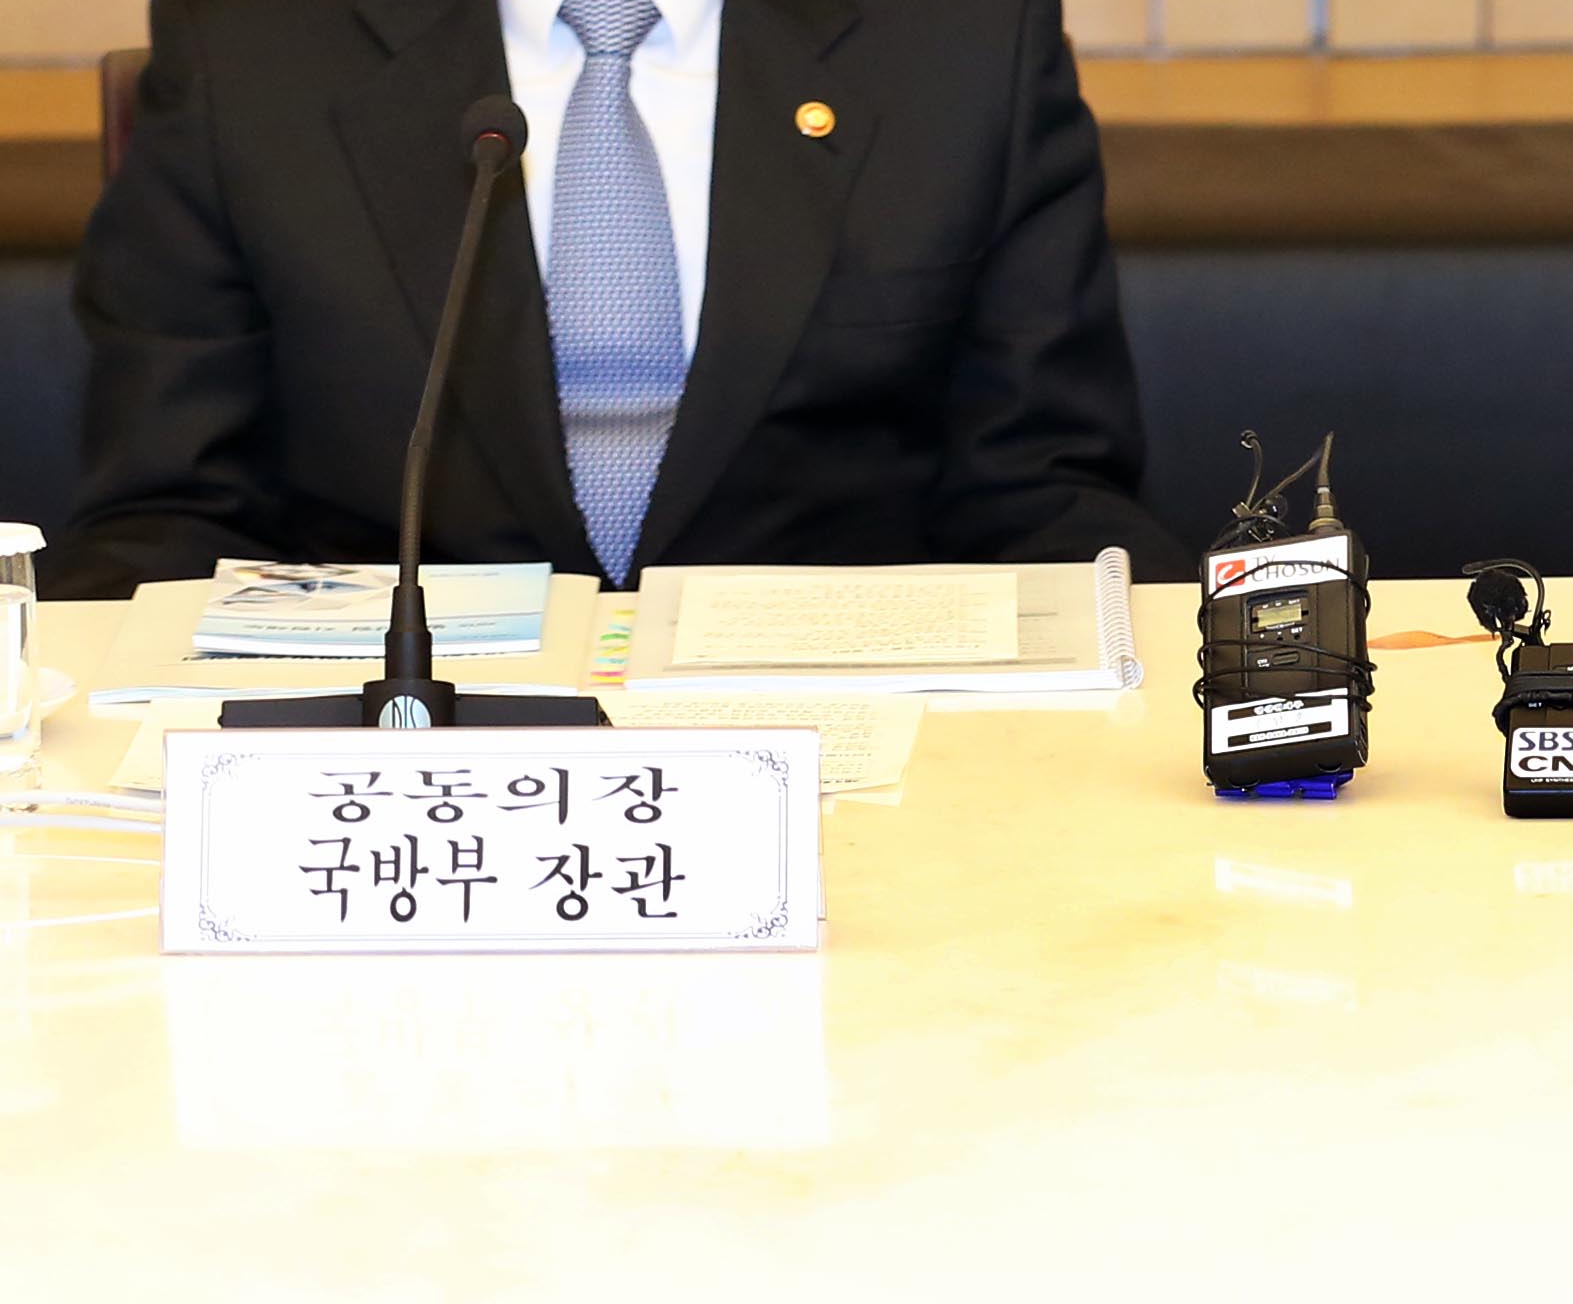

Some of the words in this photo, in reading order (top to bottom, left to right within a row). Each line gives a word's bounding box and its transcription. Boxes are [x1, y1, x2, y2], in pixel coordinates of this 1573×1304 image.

[308, 766, 679, 825] 공동의장
[298, 834, 498, 923] 국방부
[529, 843, 686, 921] 장관
